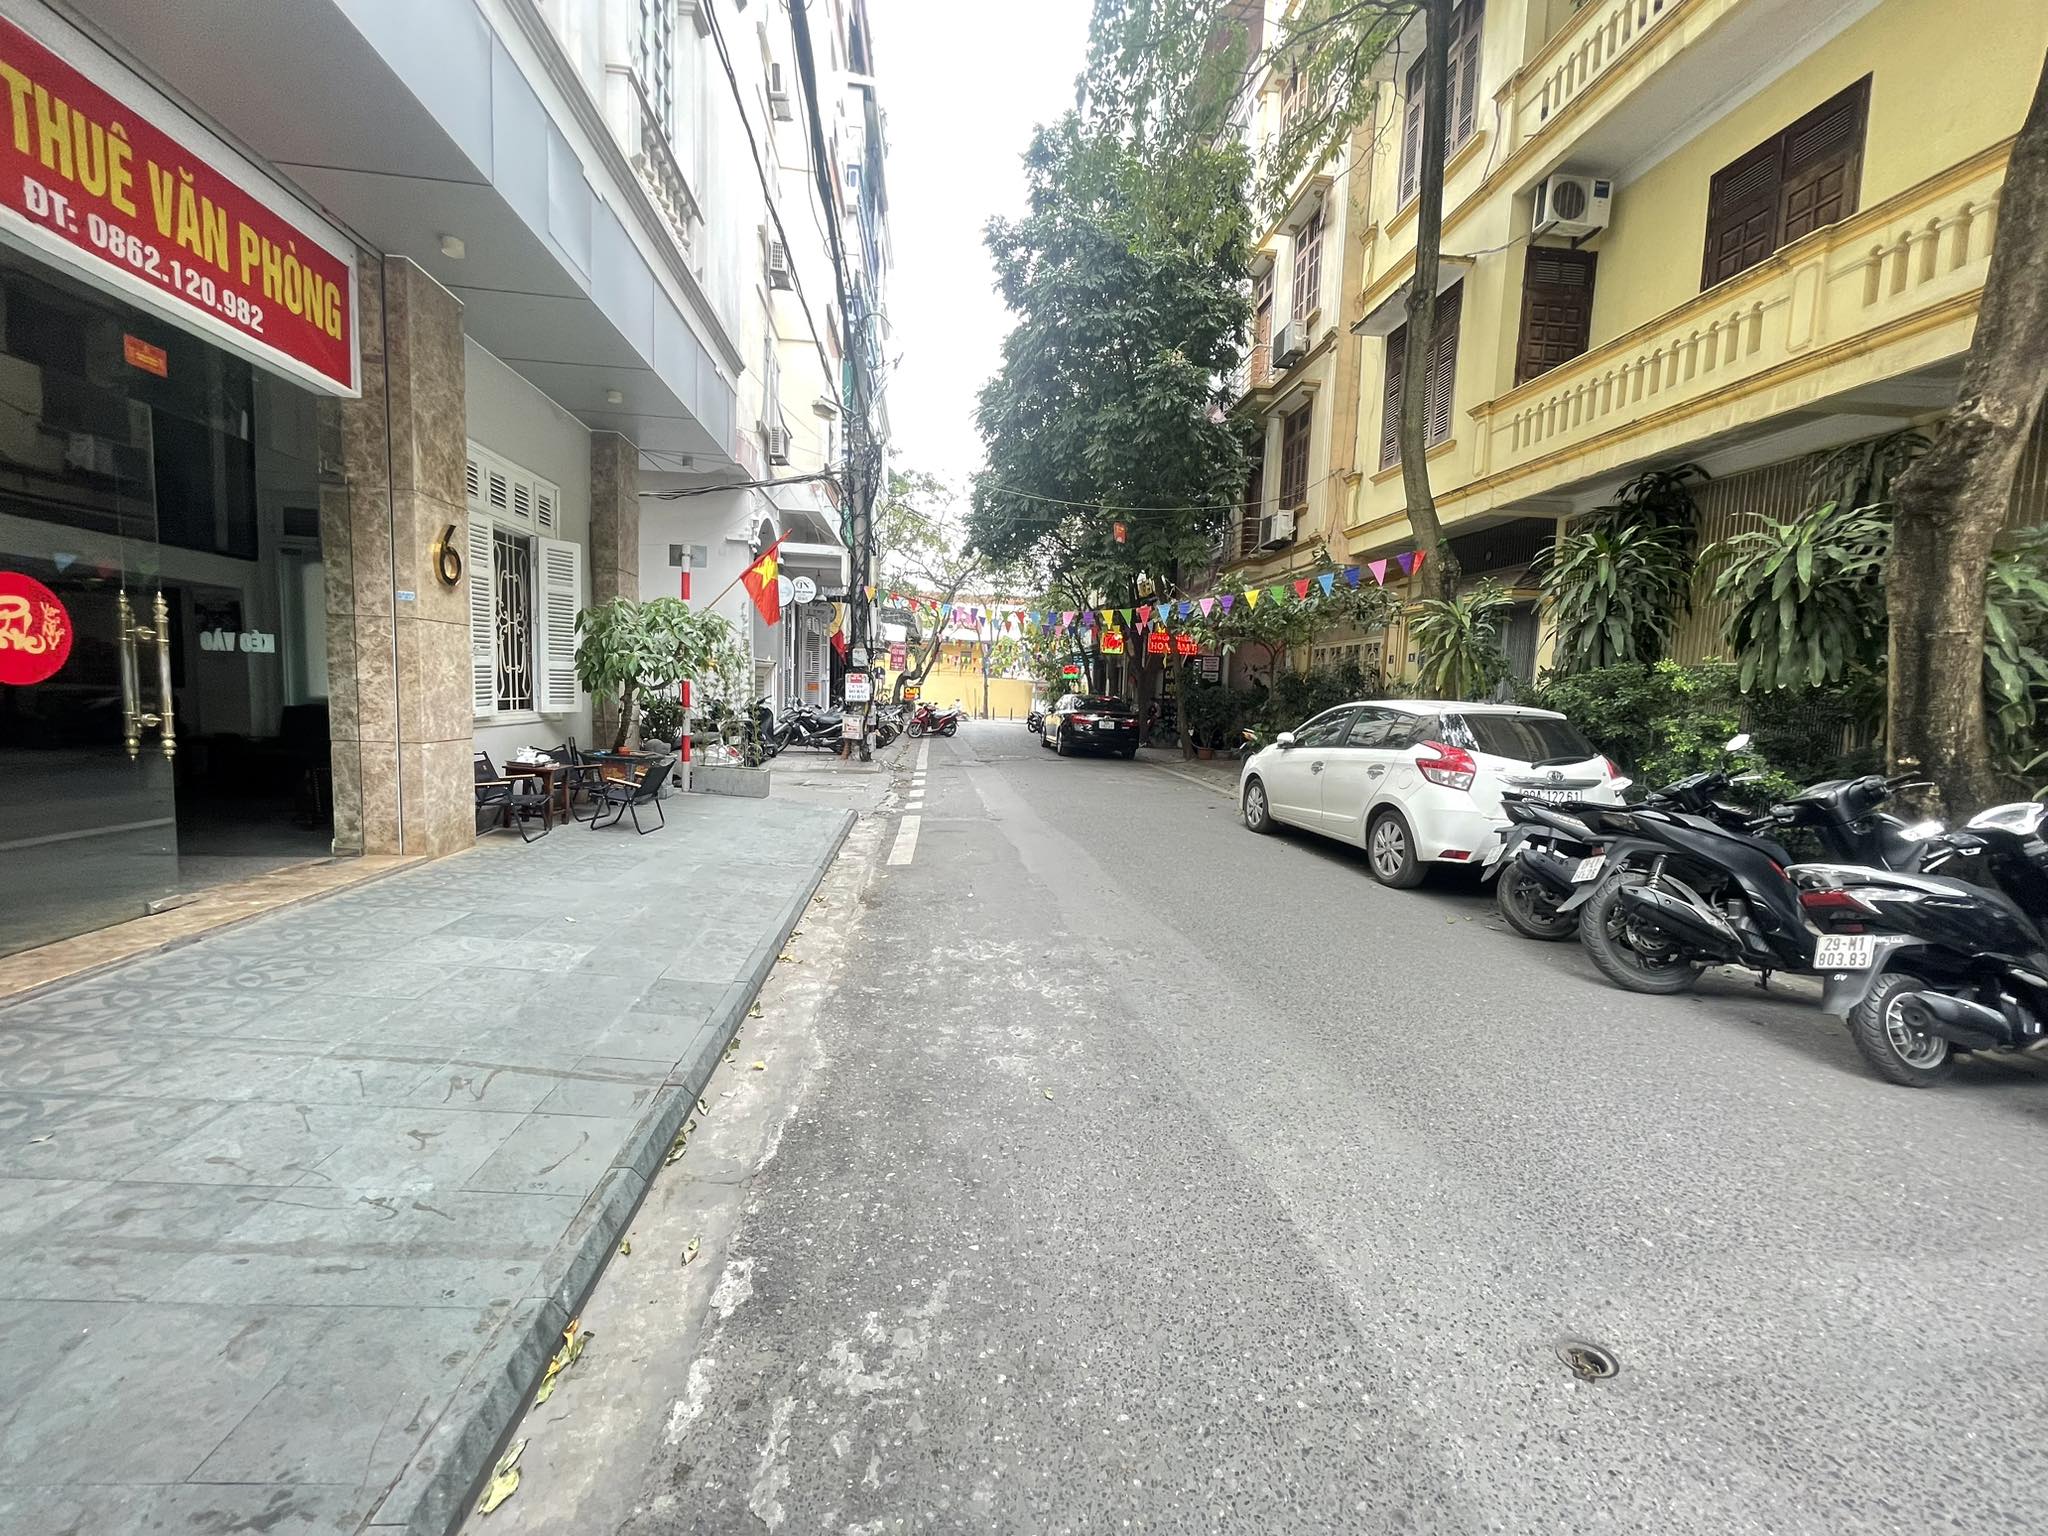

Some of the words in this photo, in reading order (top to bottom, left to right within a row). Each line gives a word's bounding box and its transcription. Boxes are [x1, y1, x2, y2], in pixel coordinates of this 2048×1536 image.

[0, 59, 136, 218] THUÊ
[148, 160, 229, 273] VĂN
[239, 222, 341, 341] PHÒNG
[23, 176, 78, 233] ĐT:
[87, 213, 264, 333] 0862.120.982
[434, 524, 462, 587] 6
[1818, 952, 1867, 967] 803.83
[1824, 937, 1865, 951] 29-M1
